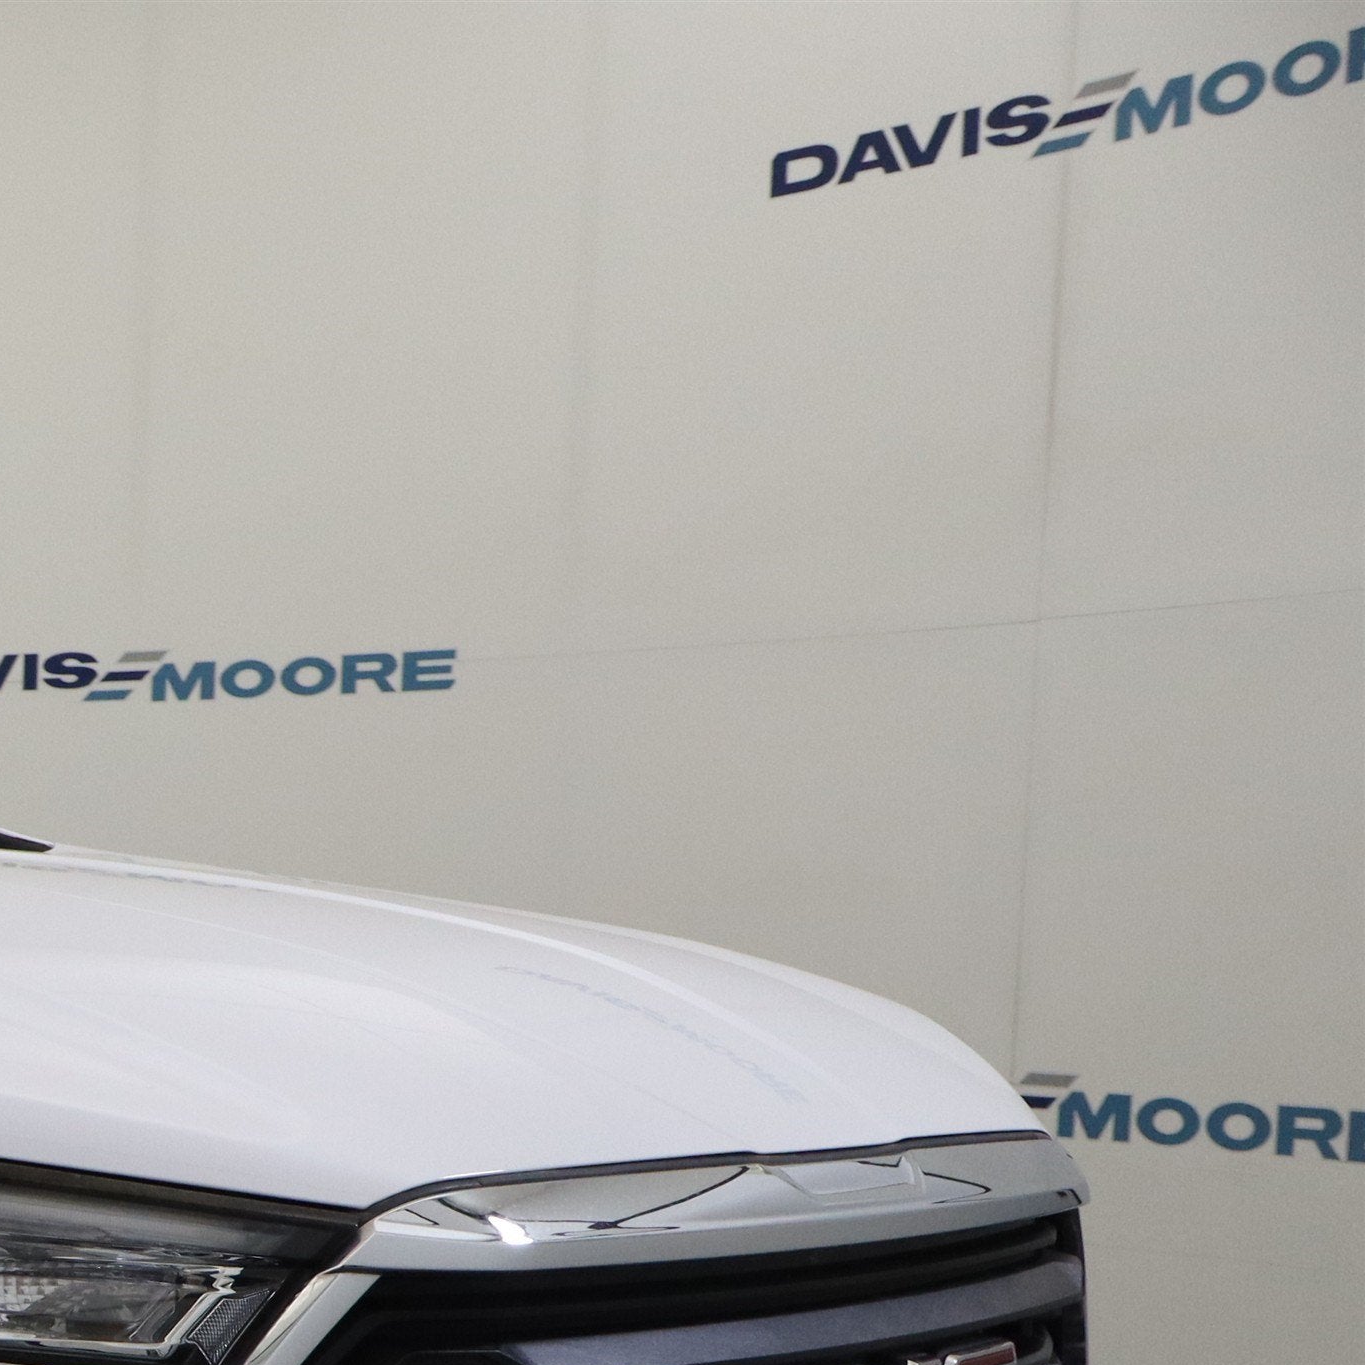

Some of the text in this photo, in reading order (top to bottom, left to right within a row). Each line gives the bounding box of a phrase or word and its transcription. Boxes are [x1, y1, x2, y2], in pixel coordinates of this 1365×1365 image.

[770, 27, 1365, 199] DAVIS MOO
[150, 649, 457, 701] MOORE
